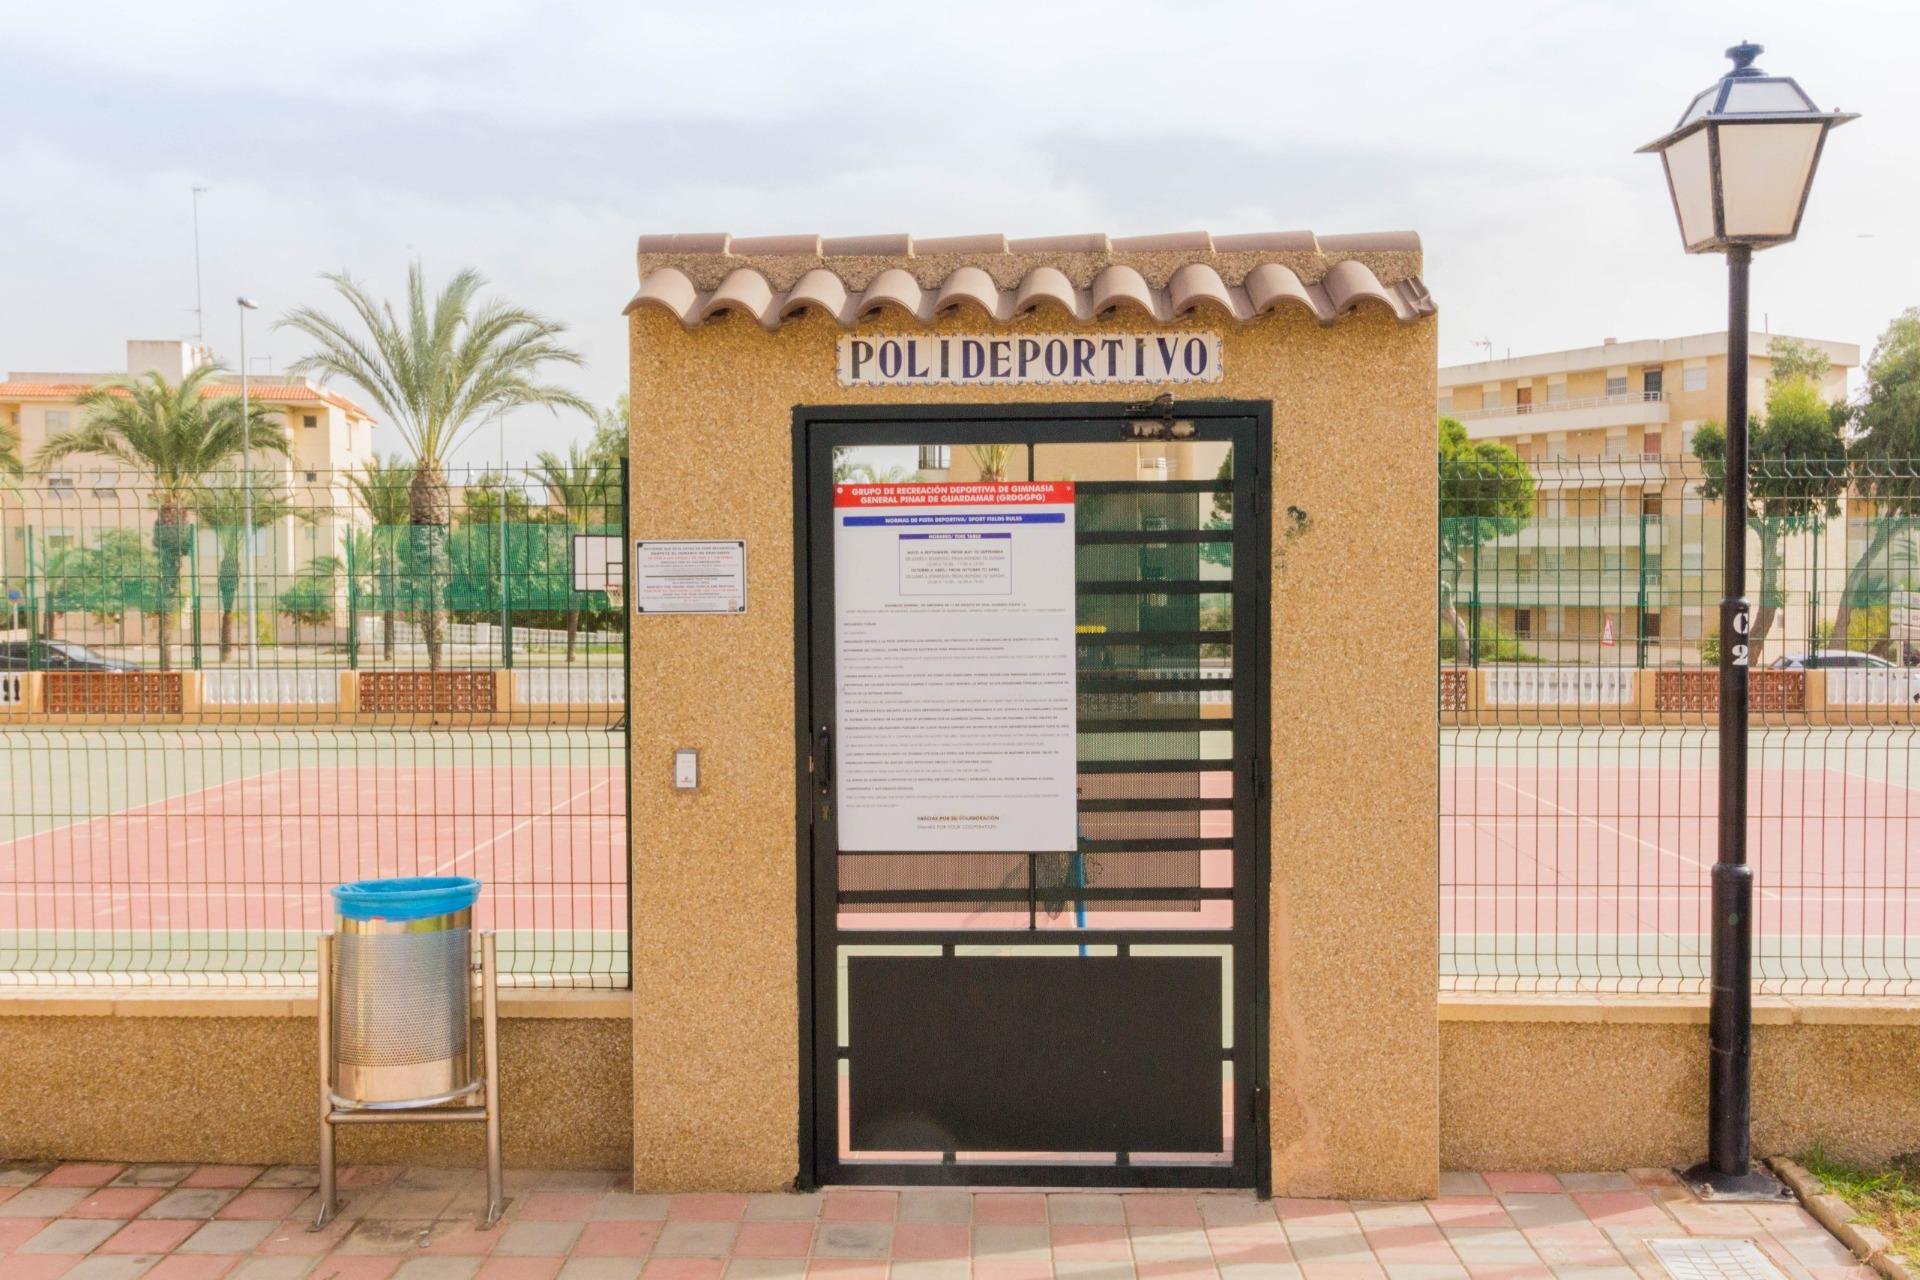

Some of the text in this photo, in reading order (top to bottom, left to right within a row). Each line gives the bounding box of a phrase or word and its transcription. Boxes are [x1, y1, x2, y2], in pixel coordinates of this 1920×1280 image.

[851, 337, 1208, 379] POLIDEPORTIVO
[851, 484, 1054, 496] GRUPO DE RECREACIÓN DEPORTIVA DE GIMNASIA
[860, 496, 898, 505] GENERAL
[900, 496, 925, 504] PINAR
[927, 495, 939, 503] DE
[940, 494, 995, 503] GUARDAMAR
